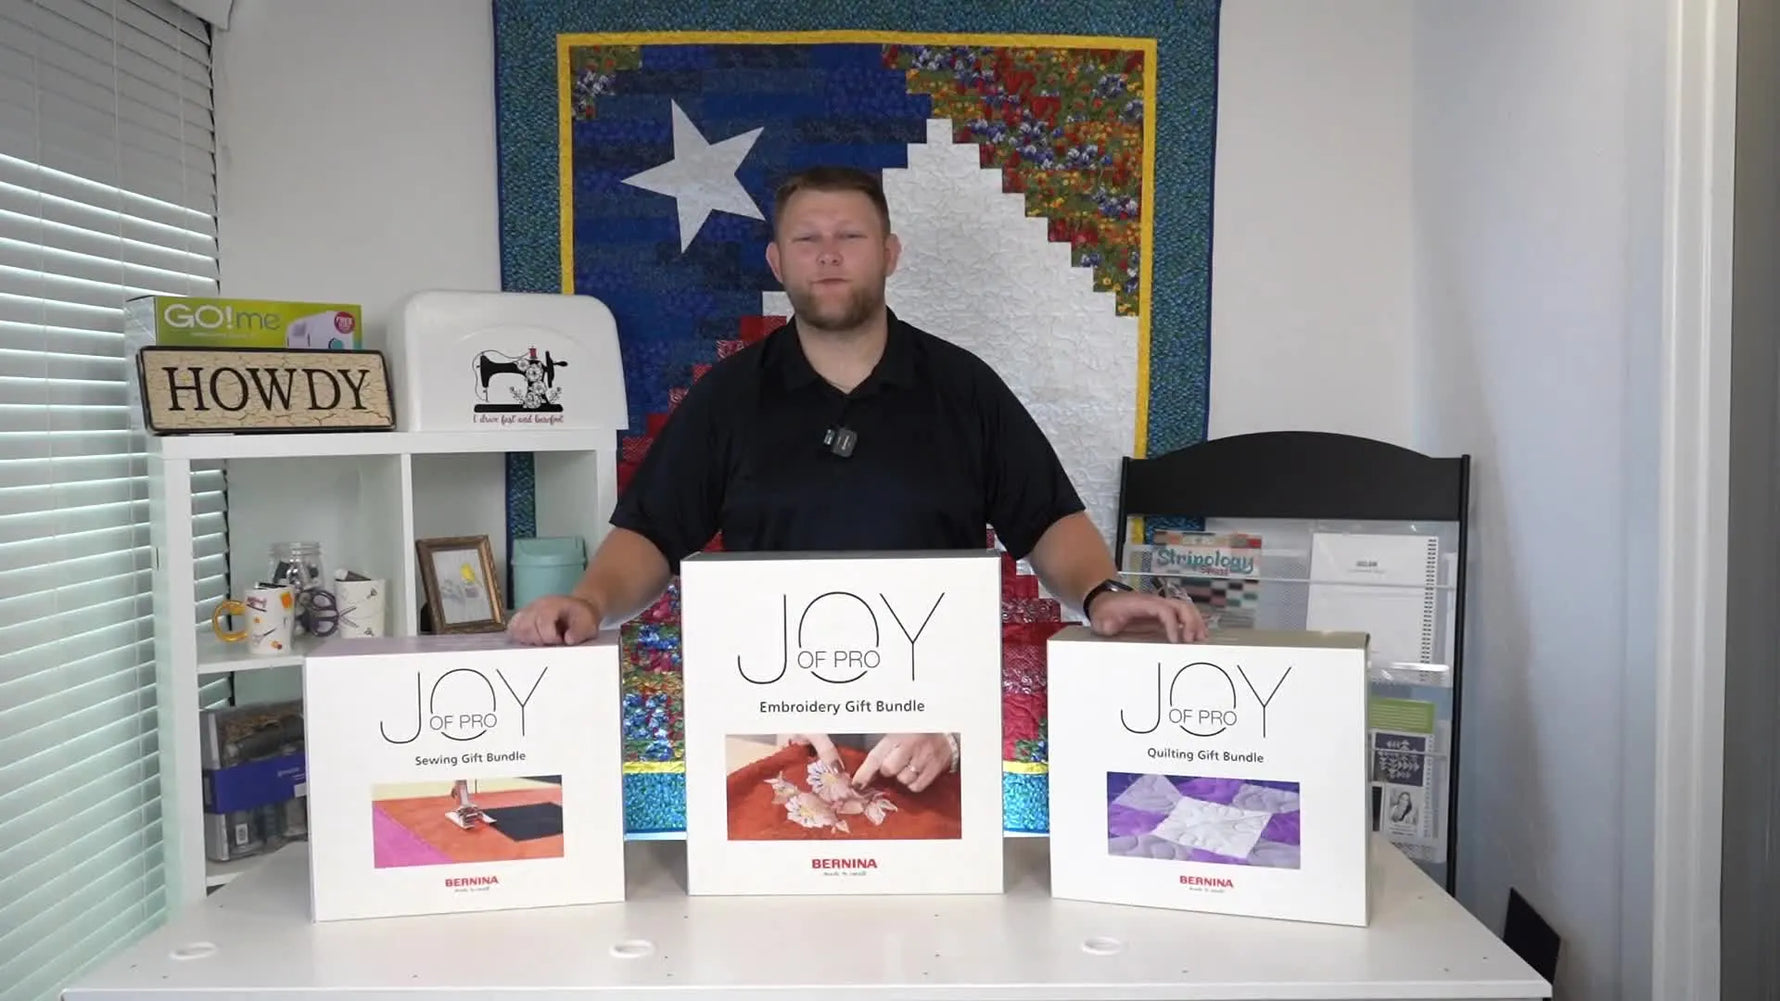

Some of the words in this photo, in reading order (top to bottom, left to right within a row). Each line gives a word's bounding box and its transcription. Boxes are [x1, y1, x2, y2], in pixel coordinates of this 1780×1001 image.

[161, 366, 370, 412] HOWDY
[1157, 547, 1254, 575] Stripology
[737, 591, 945, 685] JOY
[797, 650, 828, 670] OF
[834, 650, 881, 669] PRO
[380, 666, 549, 744] JOY
[759, 700, 840, 715] Embroidery
[845, 699, 872, 713] Gift
[876, 699, 925, 713] Bundle
[1120, 661, 1292, 738] JOY
[429, 714, 454, 731] OF
[459, 712, 498, 730] PRO
[1168, 708, 1193, 725] OF
[1198, 709, 1238, 727] PRO
[415, 755, 458, 767] Sewing
[461, 752, 483, 764] Gift
[486, 750, 526, 763] Bundle
[1147, 747, 1194, 763] Quilting
[1198, 750, 1220, 762] Gift
[1223, 751, 1264, 763] Bundle
[811, 858, 878, 869] BERNINA
[444, 875, 499, 887] BERNINA
[1179, 875, 1234, 888] BERNINA
